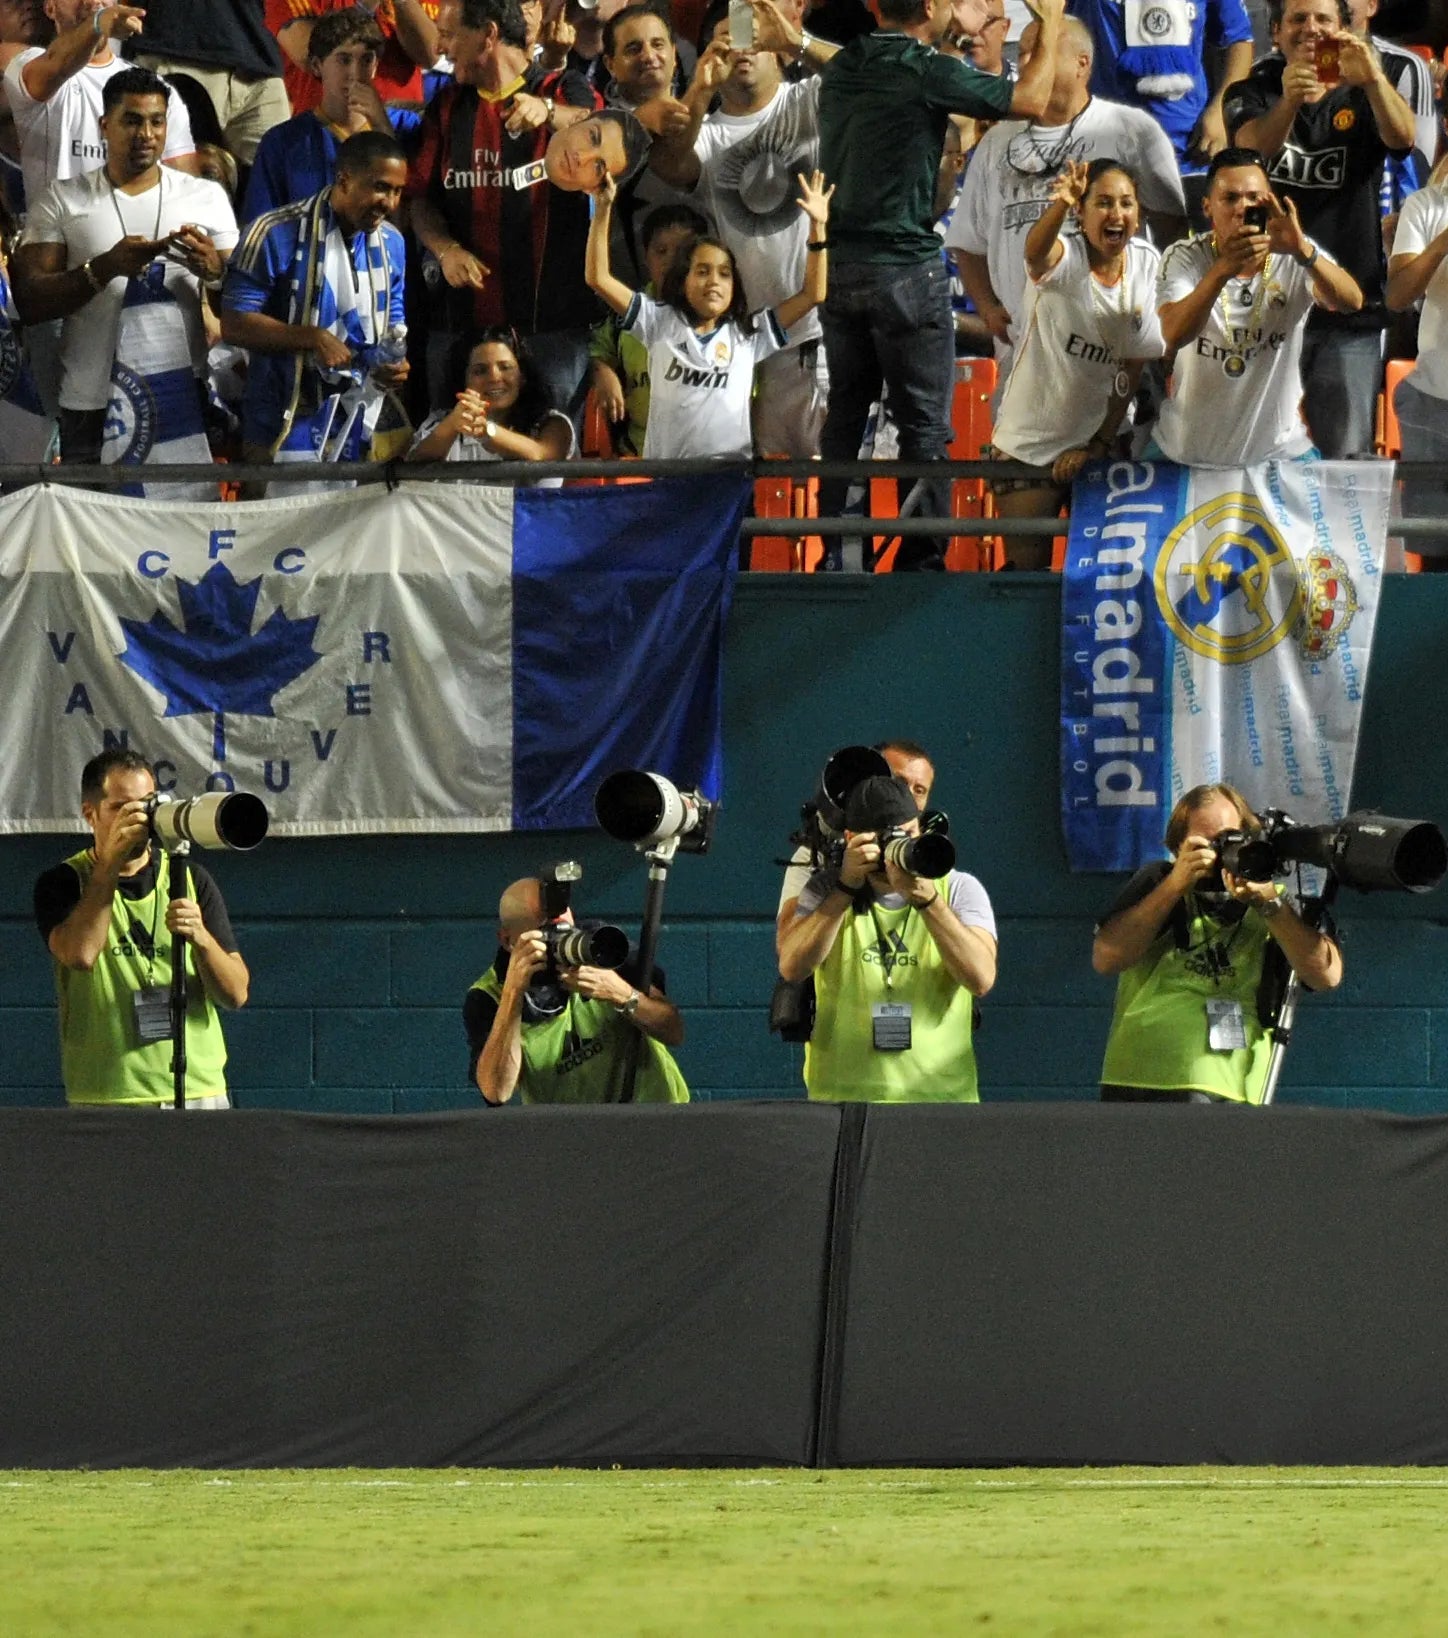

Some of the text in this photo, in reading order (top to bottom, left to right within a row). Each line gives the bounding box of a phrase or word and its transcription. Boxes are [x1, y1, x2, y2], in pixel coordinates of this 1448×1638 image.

[474, 148, 500, 166] Fly
[1271, 149, 1341, 184] AIG
[444, 166, 516, 190] Emirat
[664, 357, 729, 389] bwin
[1275, 683, 1304, 797] Realmadrid
